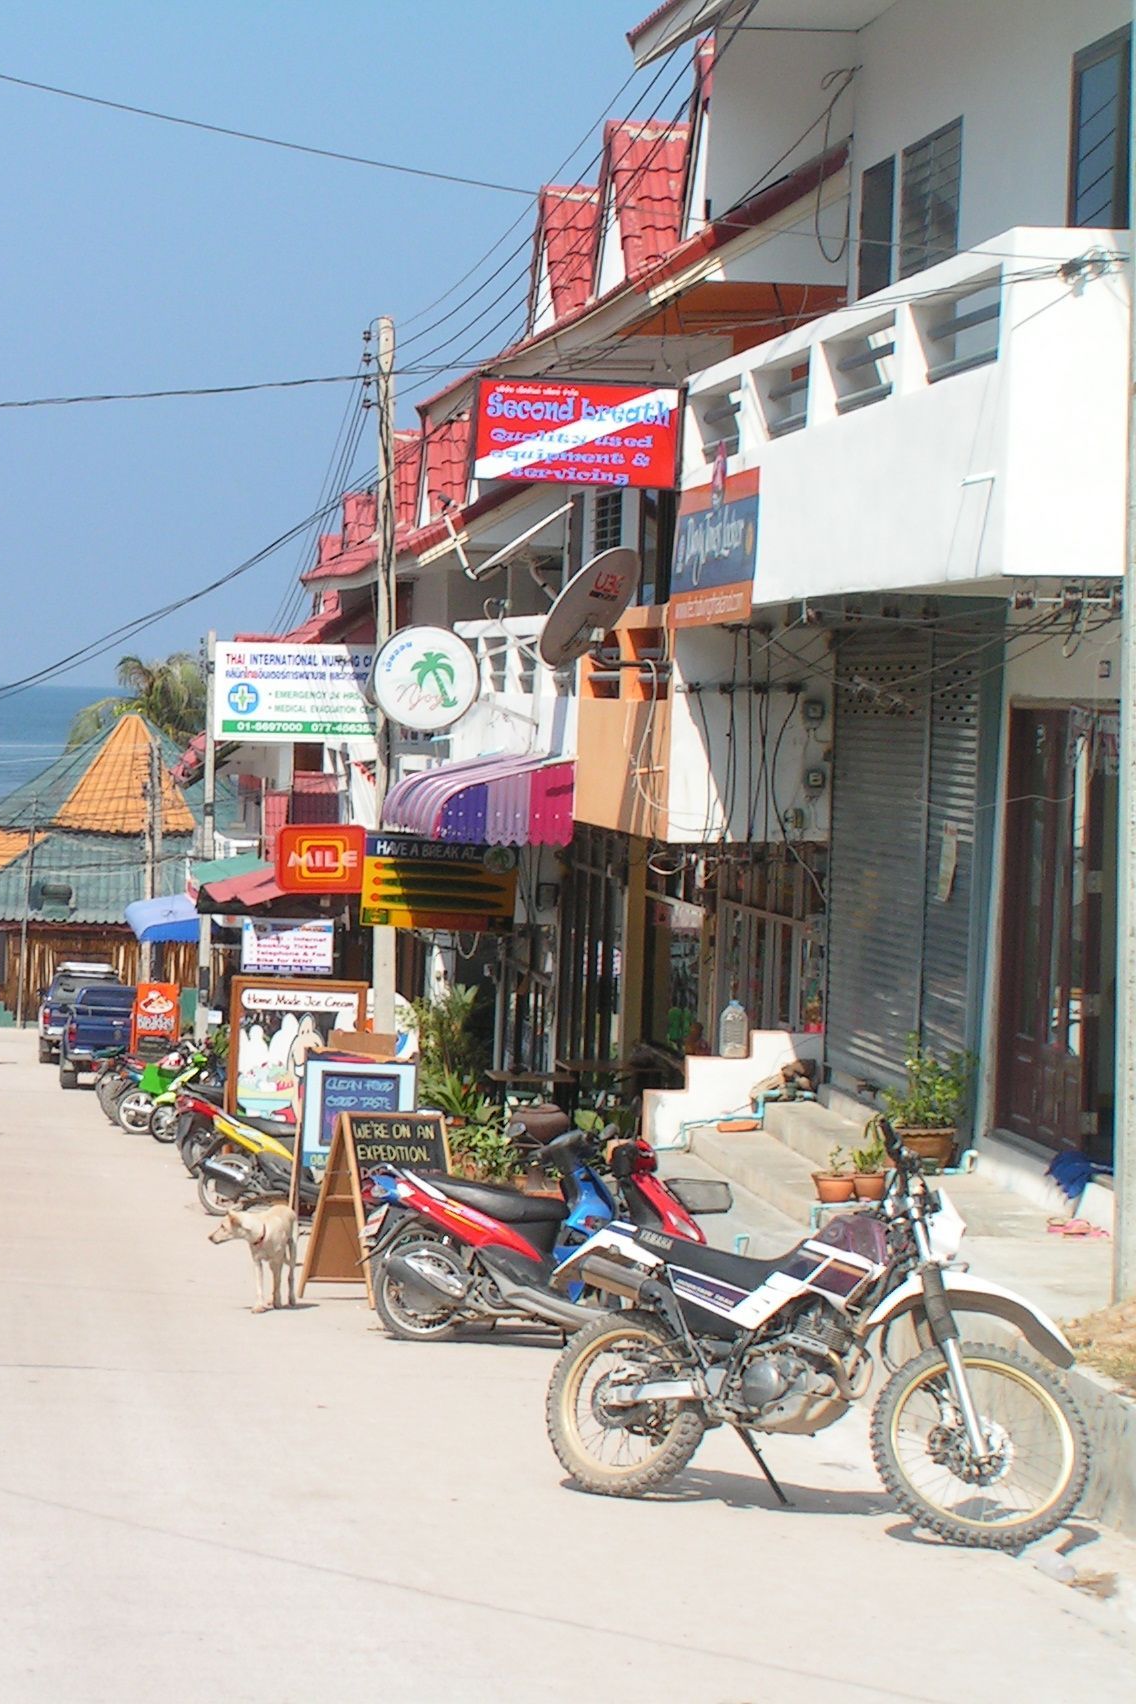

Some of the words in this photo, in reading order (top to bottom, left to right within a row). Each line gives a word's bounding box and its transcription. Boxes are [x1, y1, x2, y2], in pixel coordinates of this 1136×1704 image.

[487, 391, 574, 421] Second
[581, 398, 670, 428] breath
[490, 428, 587, 445] Quality
[595, 436, 654, 448] used
[490, 447, 625, 466] equipment
[632, 452, 650, 467] &
[226, 653, 246, 665] THAI
[250, 654, 317, 666] INTERNATIONAL
[275, 691, 326, 700] EMERGENCY
[274, 704, 306, 713] MEDICAL
[375, 839, 408, 856] HAVE
[409, 843, 420, 857] A
[421, 844, 460, 858] BREAK
[247, 993, 272, 1005] Home
[275, 994, 302, 1006] Made
[304, 995, 322, 1007] Ice
[324, 995, 355, 1008] Cream
[325, 1078, 363, 1092] CLEAN
[352, 1121, 390, 1139] WE'RE
[392, 1123, 411, 1139] ON
[416, 1124, 435, 1140] AN
[357, 1144, 431, 1162] EXPEDITION.
